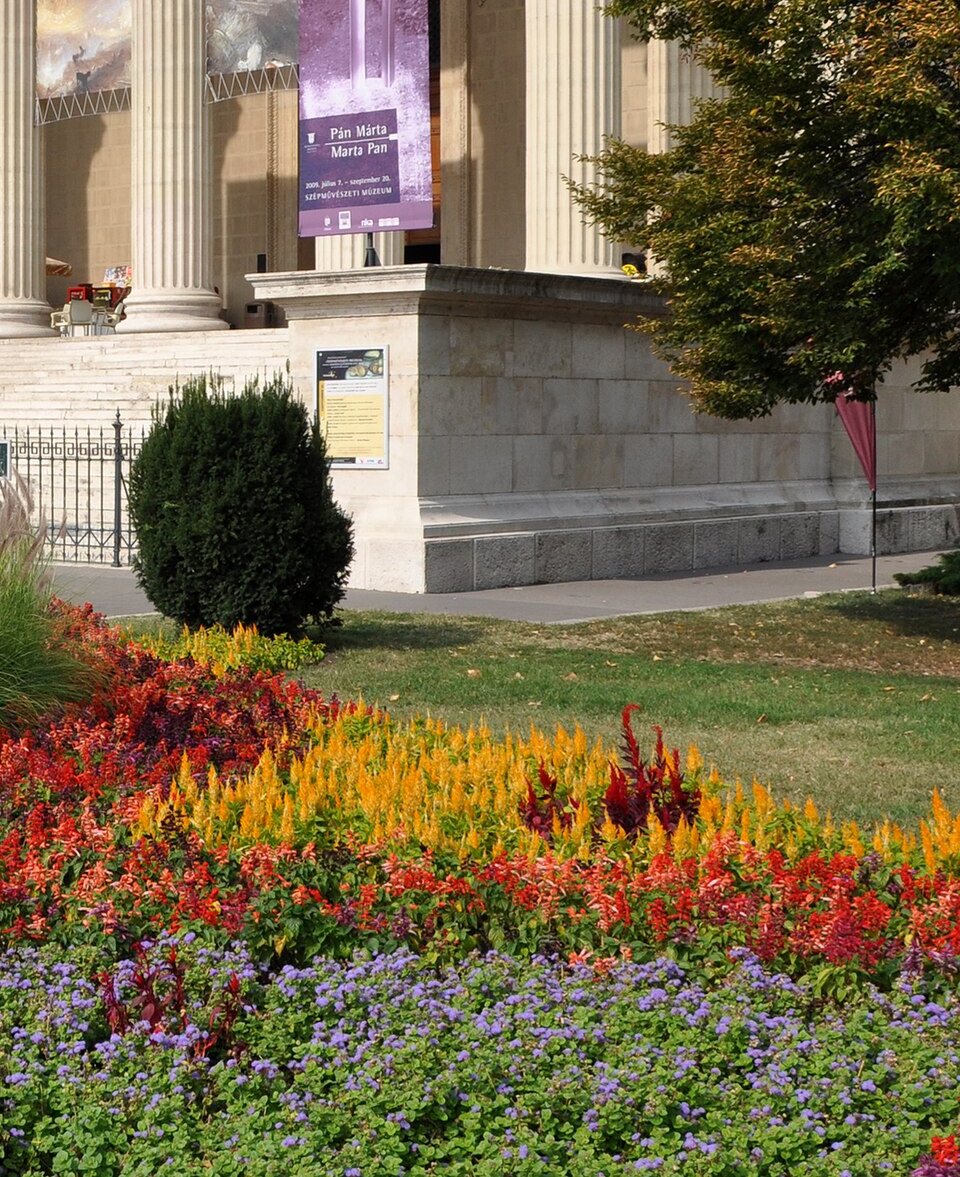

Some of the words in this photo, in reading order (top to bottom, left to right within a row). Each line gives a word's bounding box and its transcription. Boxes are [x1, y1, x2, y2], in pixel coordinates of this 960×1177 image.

[330, 126, 351, 140] Pán
[356, 124, 387, 138] Márta
[331, 145, 363, 158] Marta
[367, 142, 388, 155] Pan
